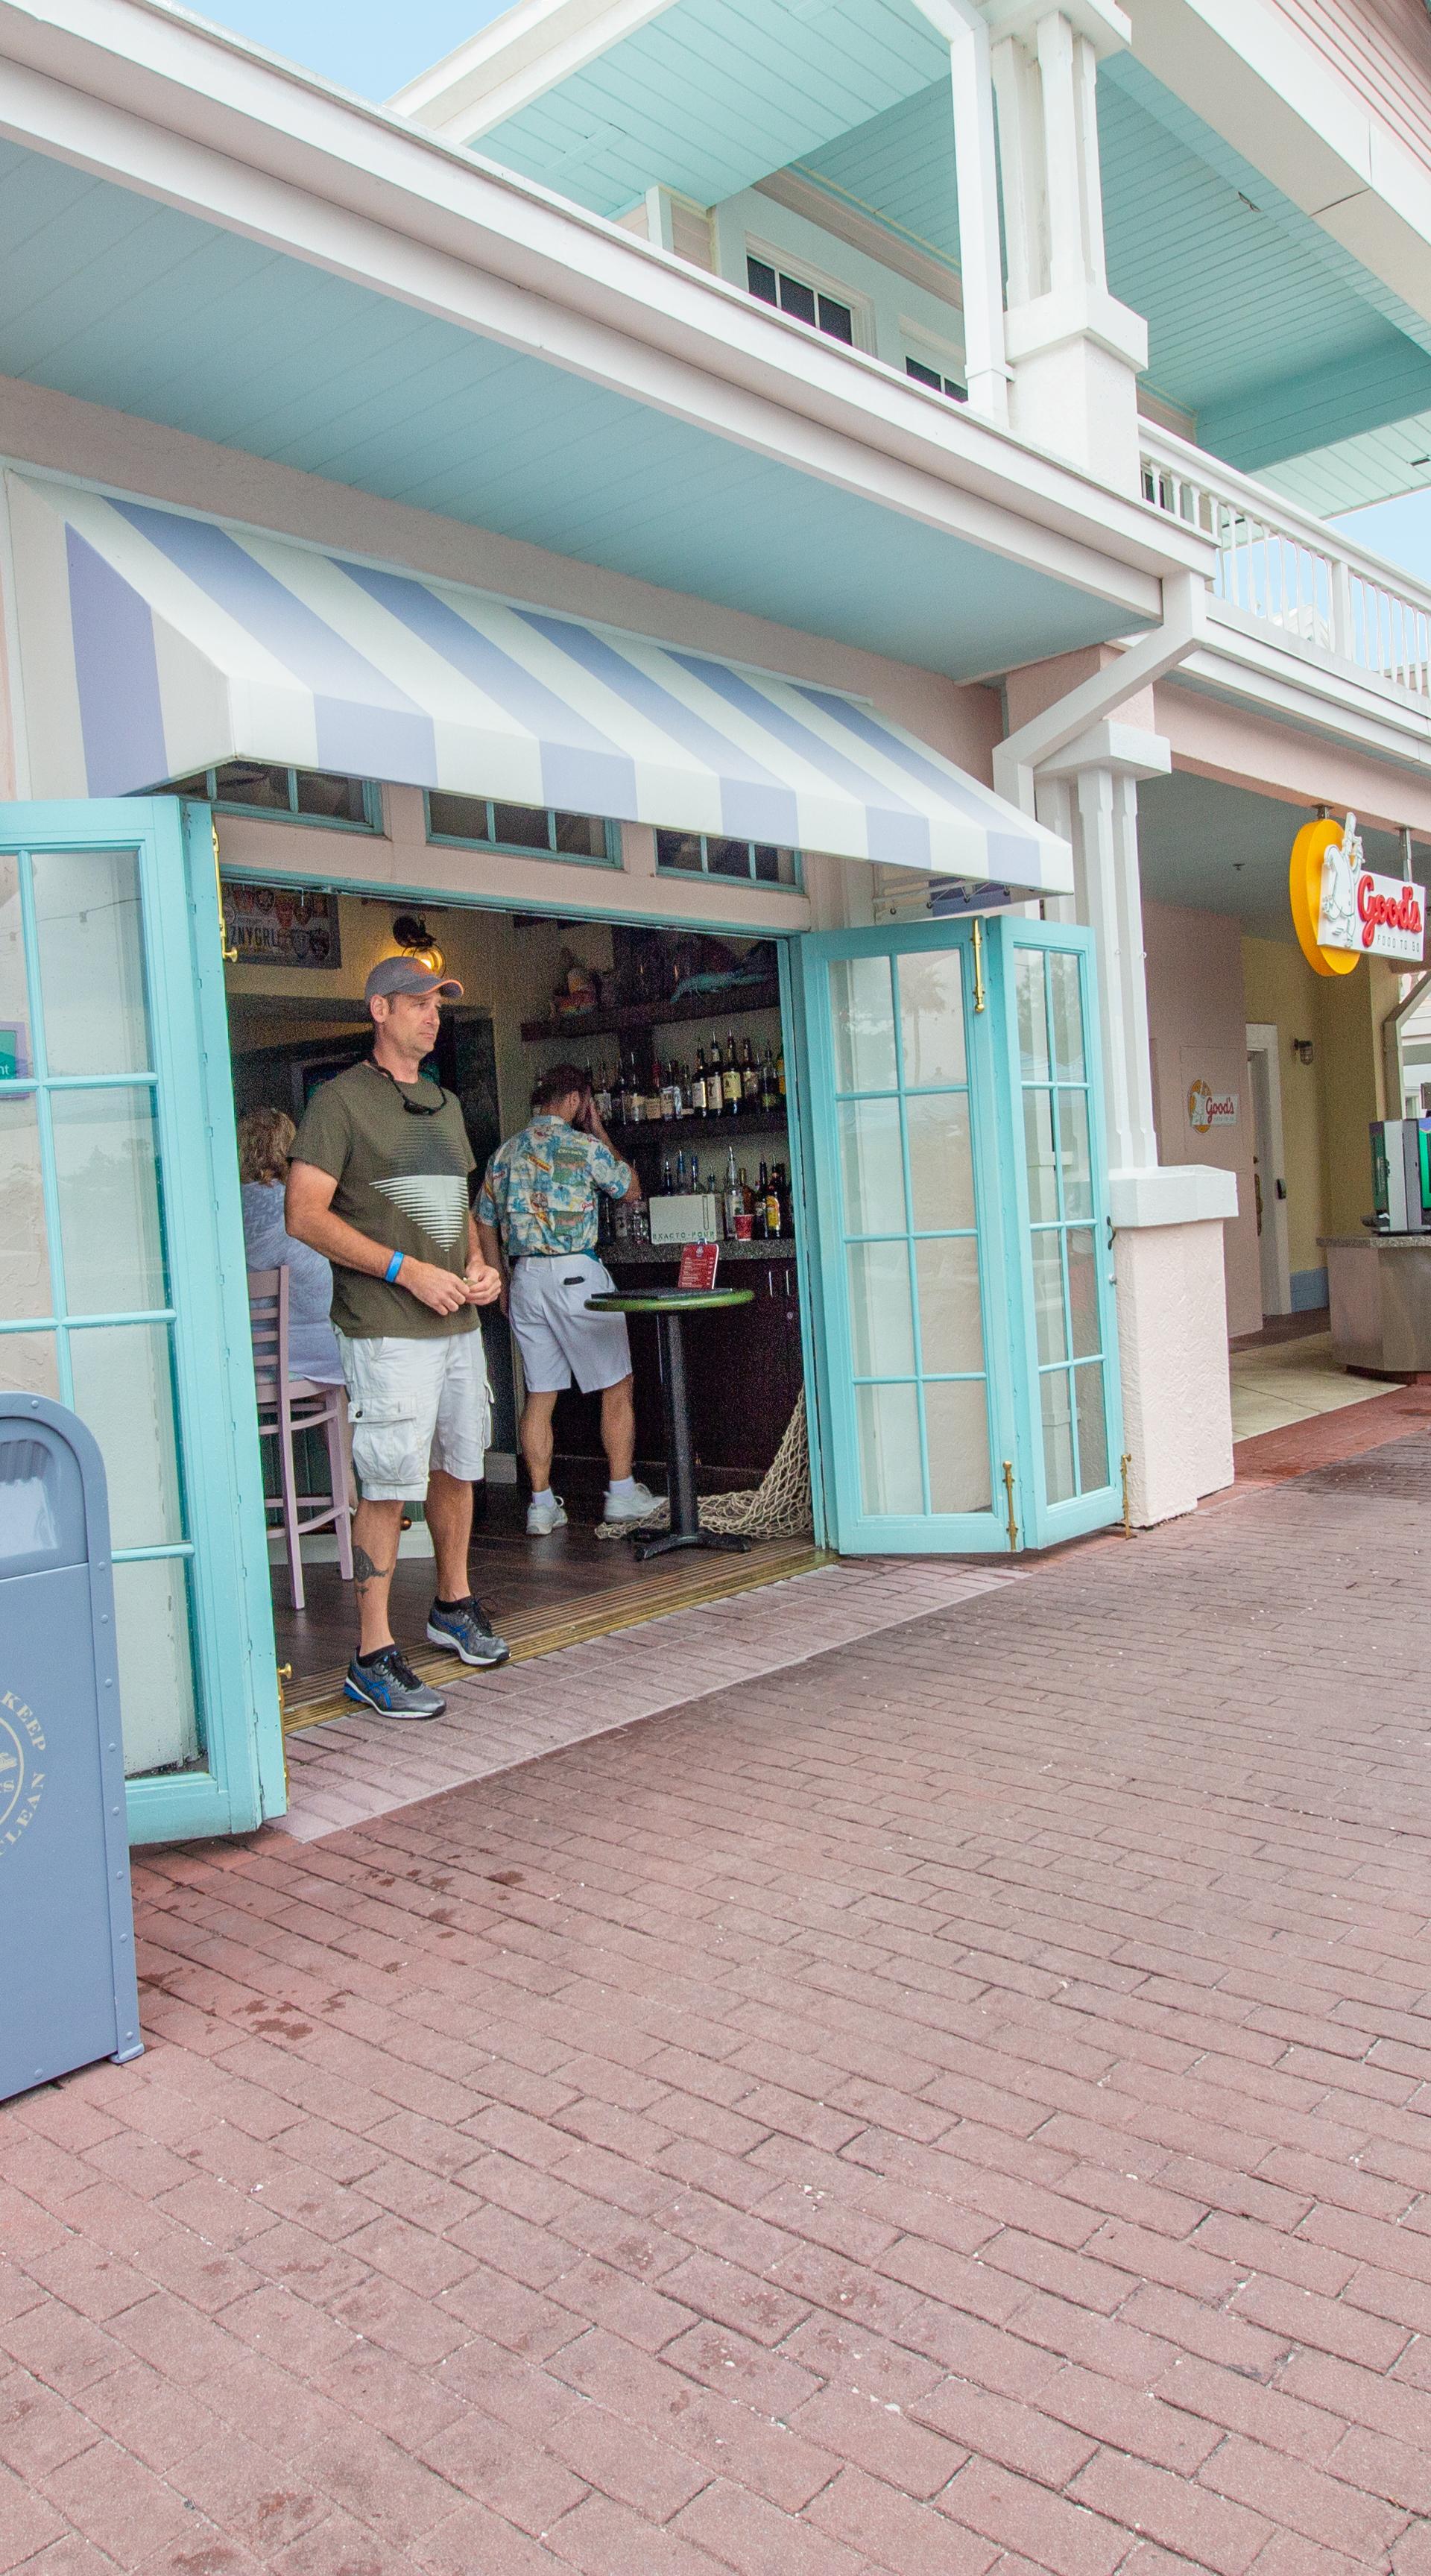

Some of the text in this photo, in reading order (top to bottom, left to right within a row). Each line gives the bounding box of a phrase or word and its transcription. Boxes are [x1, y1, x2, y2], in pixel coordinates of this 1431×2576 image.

[1357, 874, 1422, 947] Good's
[1377, 934, 1420, 953] FOOD TO GO
[1205, 1096, 1235, 1124] Good's
[1, 1690, 46, 1751] KEEP
